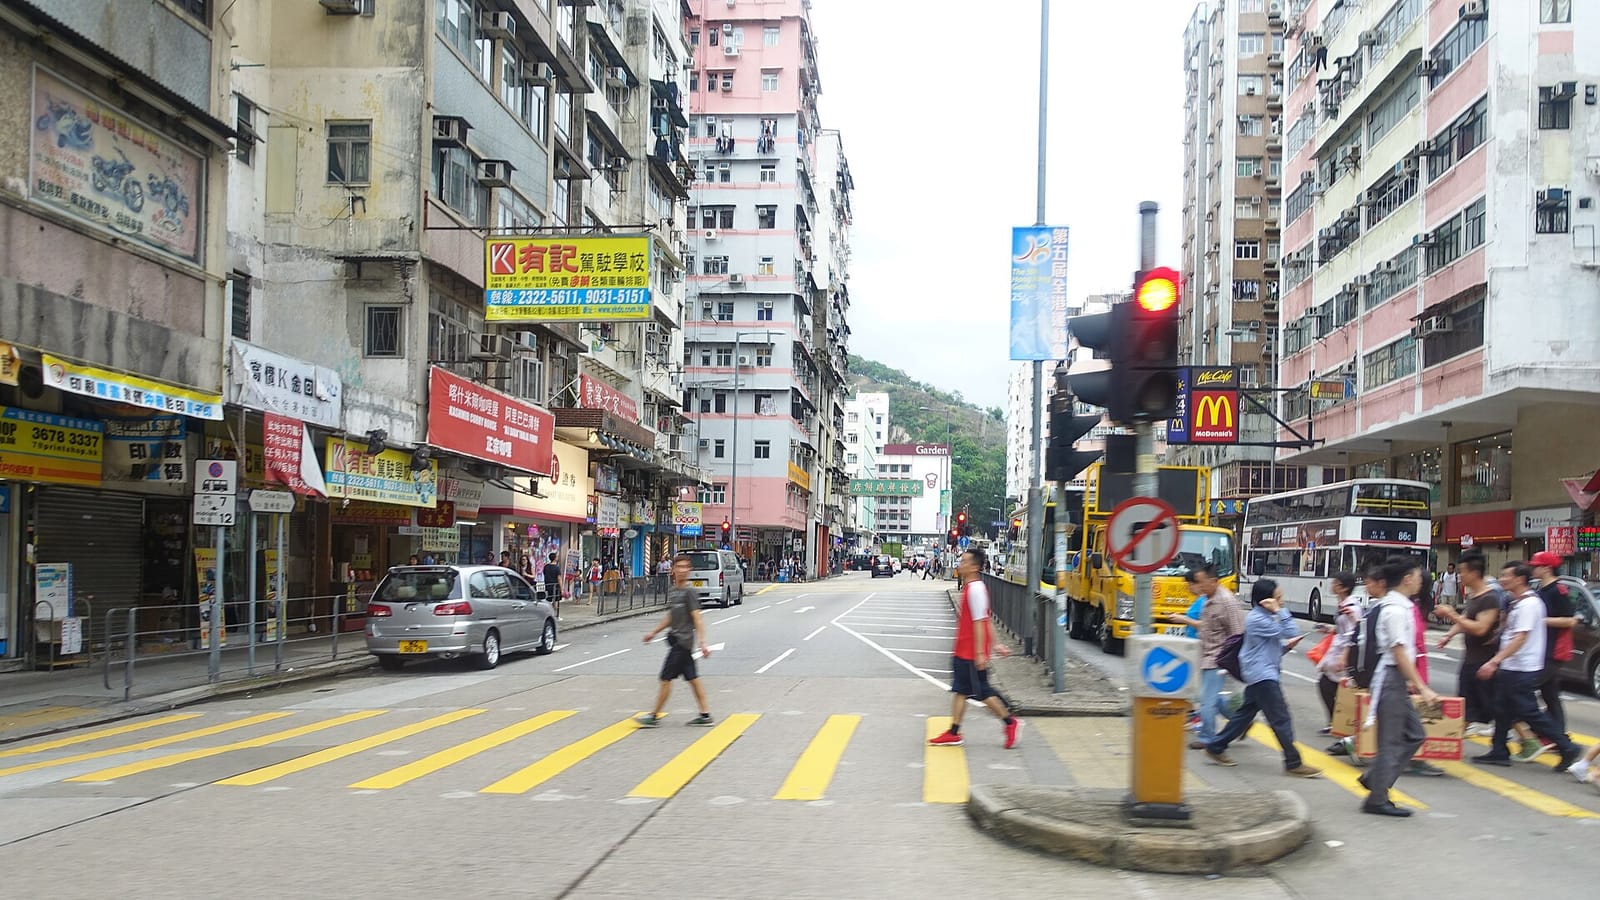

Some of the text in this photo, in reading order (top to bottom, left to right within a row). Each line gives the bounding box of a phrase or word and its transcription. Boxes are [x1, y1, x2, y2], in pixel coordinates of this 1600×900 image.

[519, 243, 645, 273] 有記 駕駛學校
[585, 289, 644, 304] 9031-5151
[32, 427, 65, 443] 3678
[69, 432, 99, 447] 3337
[916, 445, 948, 455] Garden
[220, 497, 227, 506] 7
[220, 513, 233, 523] 12
